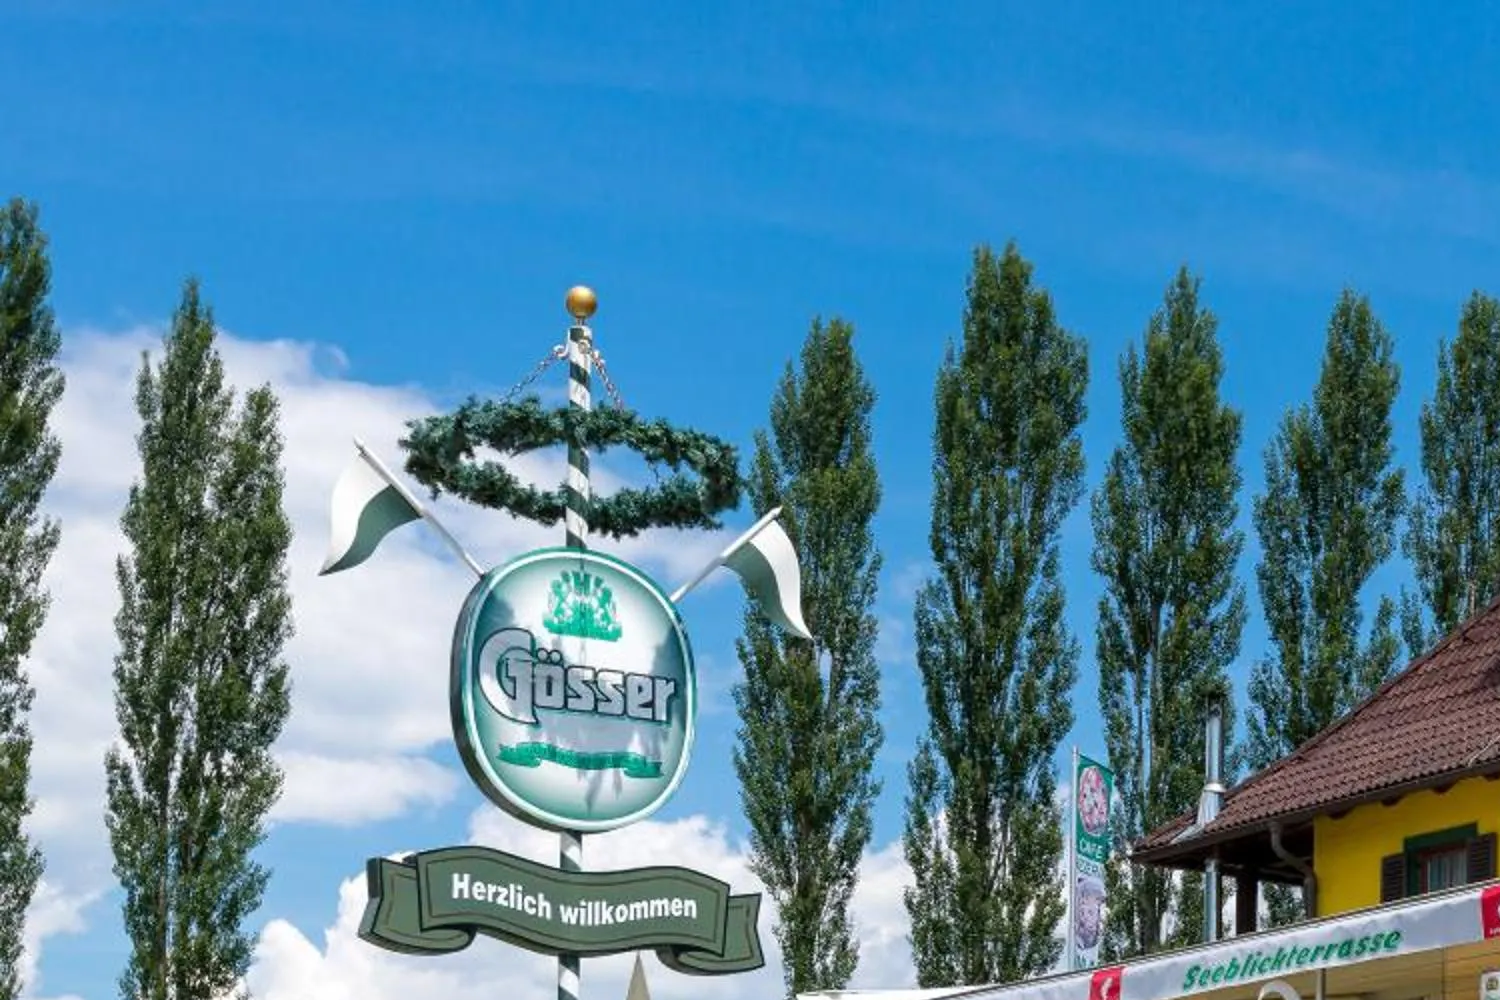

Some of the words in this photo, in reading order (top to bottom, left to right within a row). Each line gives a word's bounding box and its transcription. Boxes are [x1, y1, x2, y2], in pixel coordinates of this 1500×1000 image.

[478, 627, 677, 725] Gösser
[452, 873, 552, 920] Herzlich
[559, 897, 697, 926] willkommen
[1183, 929, 1403, 992] Seeblickterrasse
